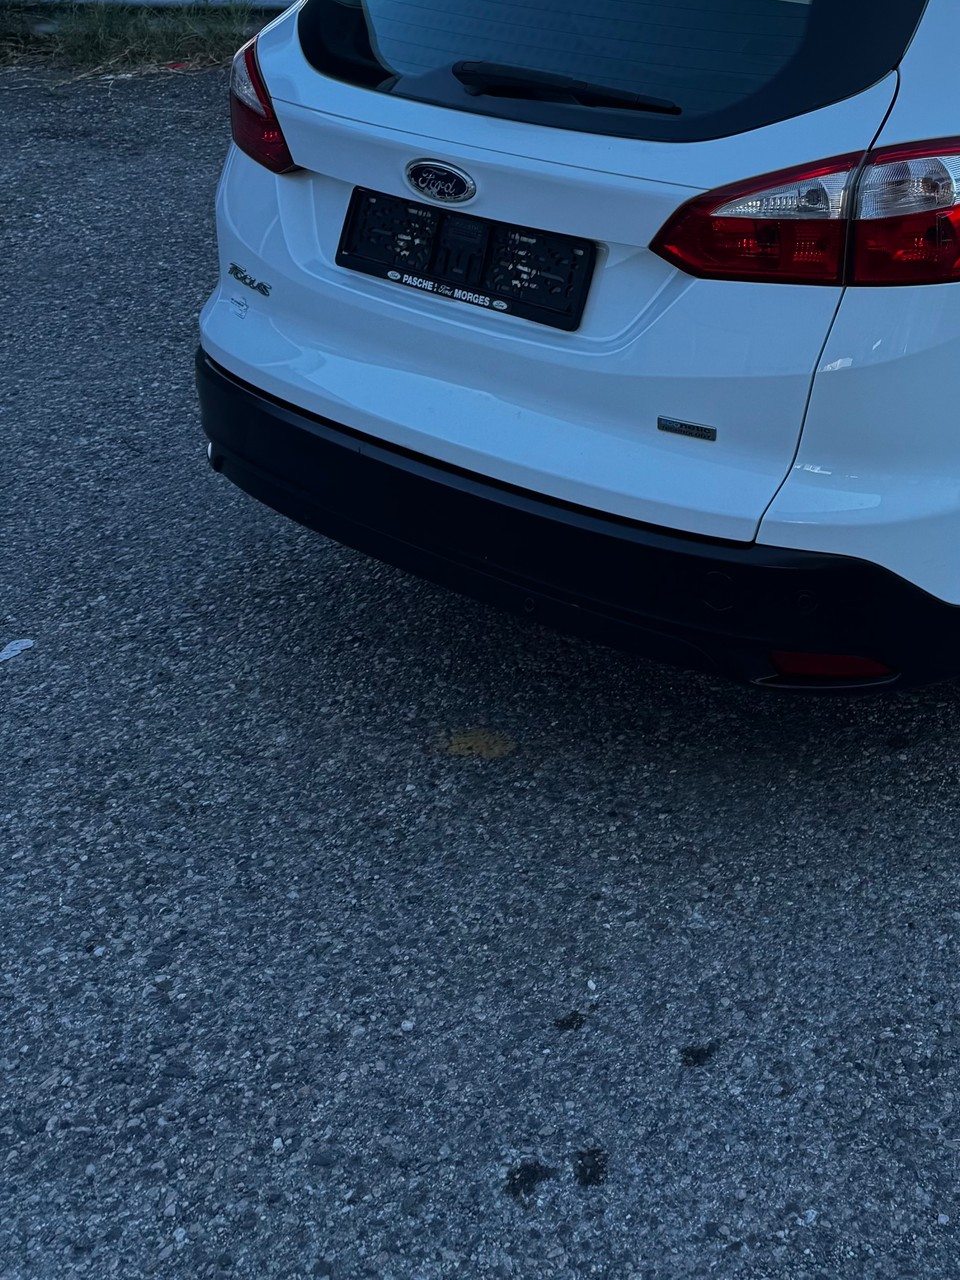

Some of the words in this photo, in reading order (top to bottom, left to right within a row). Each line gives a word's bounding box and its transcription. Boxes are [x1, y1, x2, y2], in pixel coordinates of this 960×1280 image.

[418, 167, 457, 194] Ford
[402, 274, 433, 291] PASCHE
[453, 288, 490, 306] MORGES
